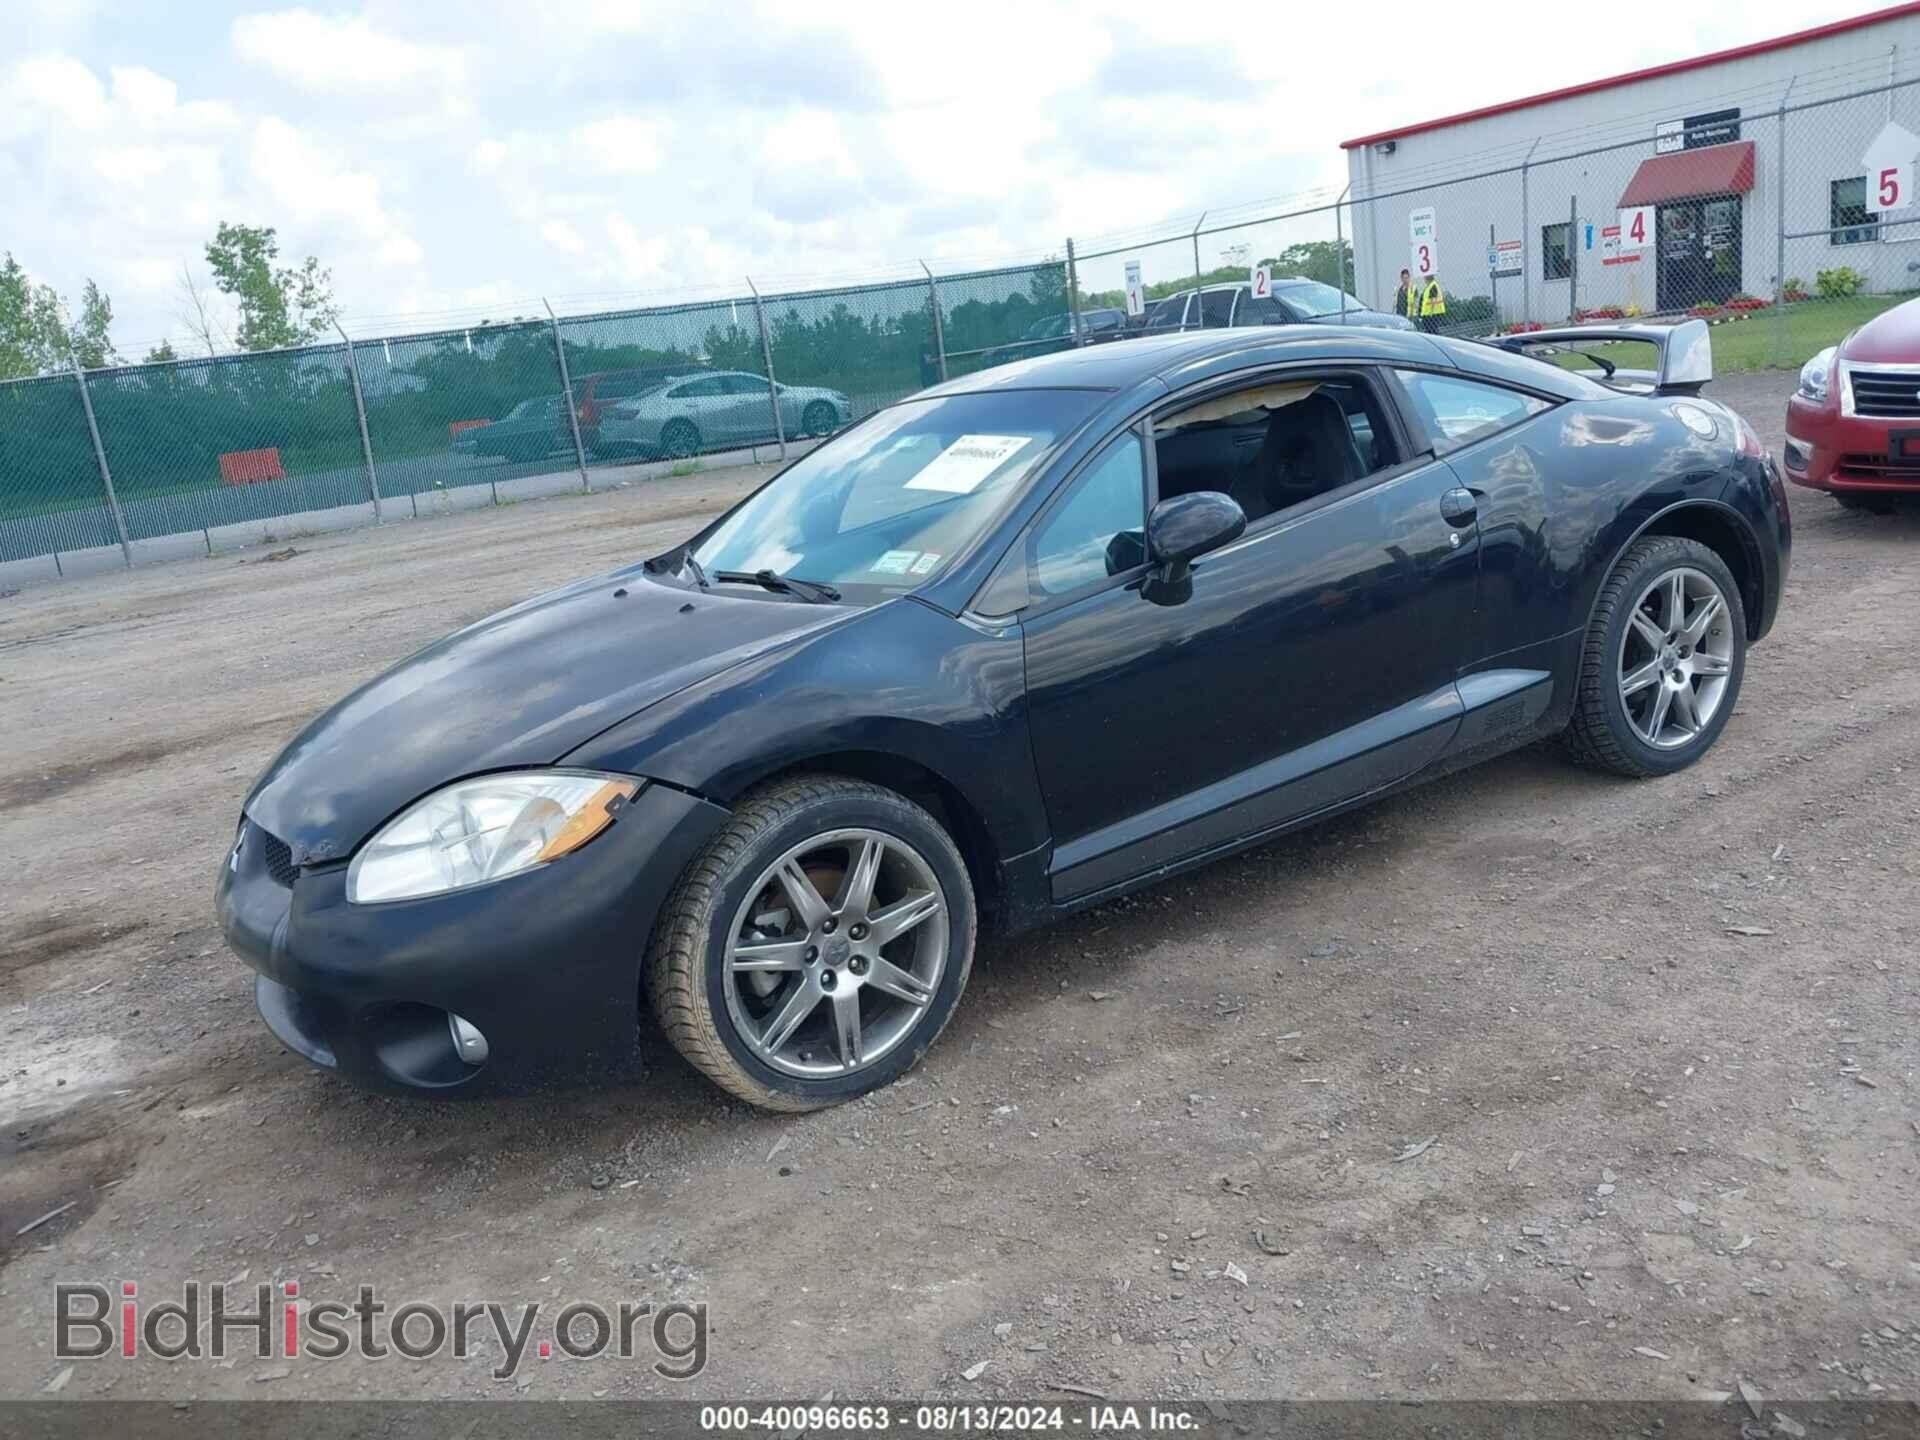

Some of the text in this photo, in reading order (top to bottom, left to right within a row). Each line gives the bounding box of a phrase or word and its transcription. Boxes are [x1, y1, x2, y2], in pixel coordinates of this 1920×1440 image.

[1879, 167, 1899, 207] 5
[1630, 211, 1646, 244] 4
[1418, 246, 1430, 273] 3
[1256, 271, 1266, 295] 2
[1130, 289, 1139, 313] 1
